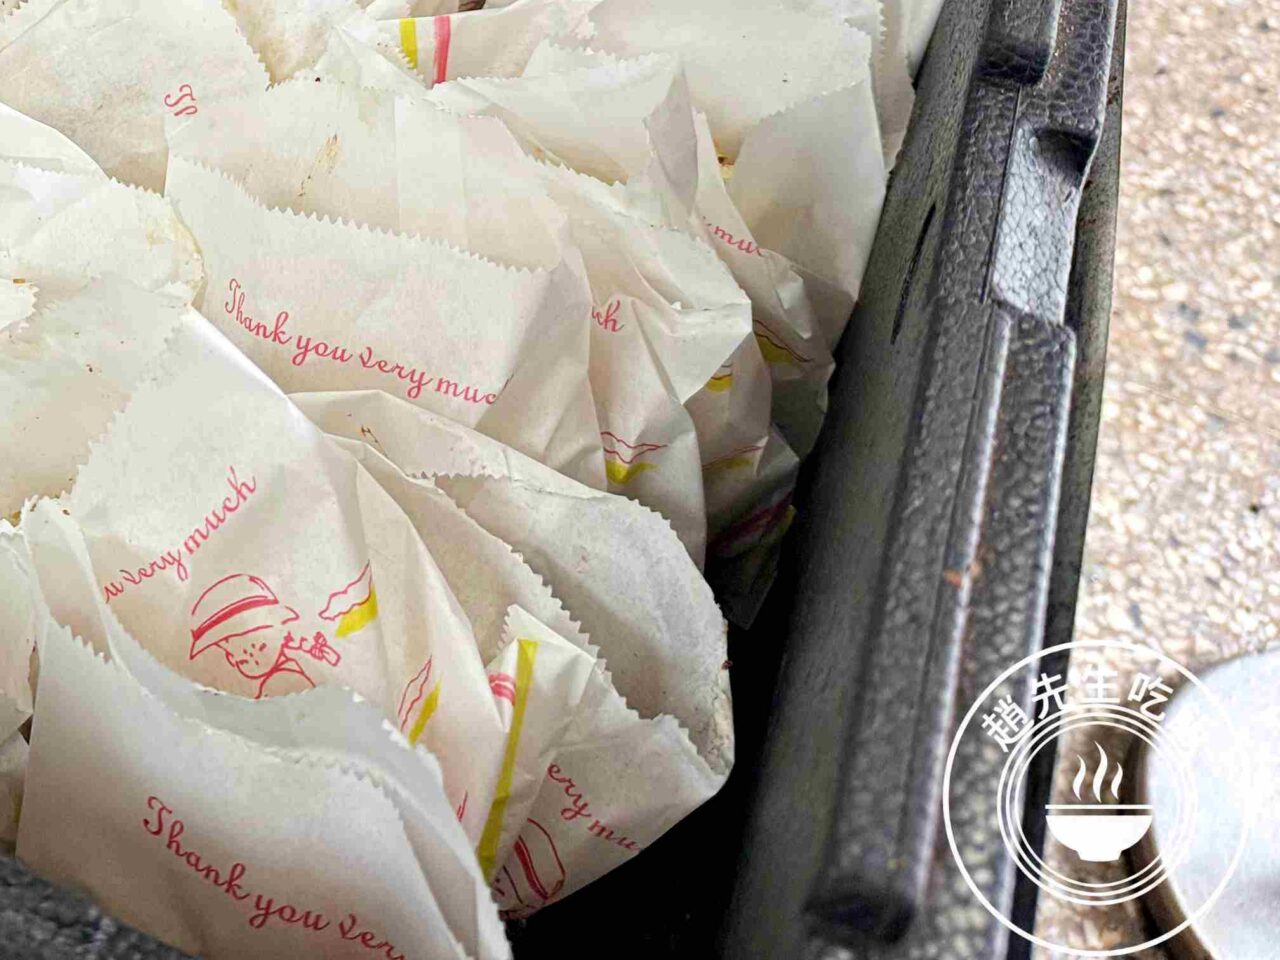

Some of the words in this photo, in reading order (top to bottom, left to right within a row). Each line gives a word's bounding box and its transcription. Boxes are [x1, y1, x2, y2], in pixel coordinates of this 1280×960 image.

[224, 278, 292, 345] Thank
[291, 334, 354, 367] you
[435, 375, 498, 406] muc
[183, 465, 257, 555] much
[547, 763, 592, 820] ery
[143, 795, 251, 901] Thank
[248, 890, 330, 930] you
